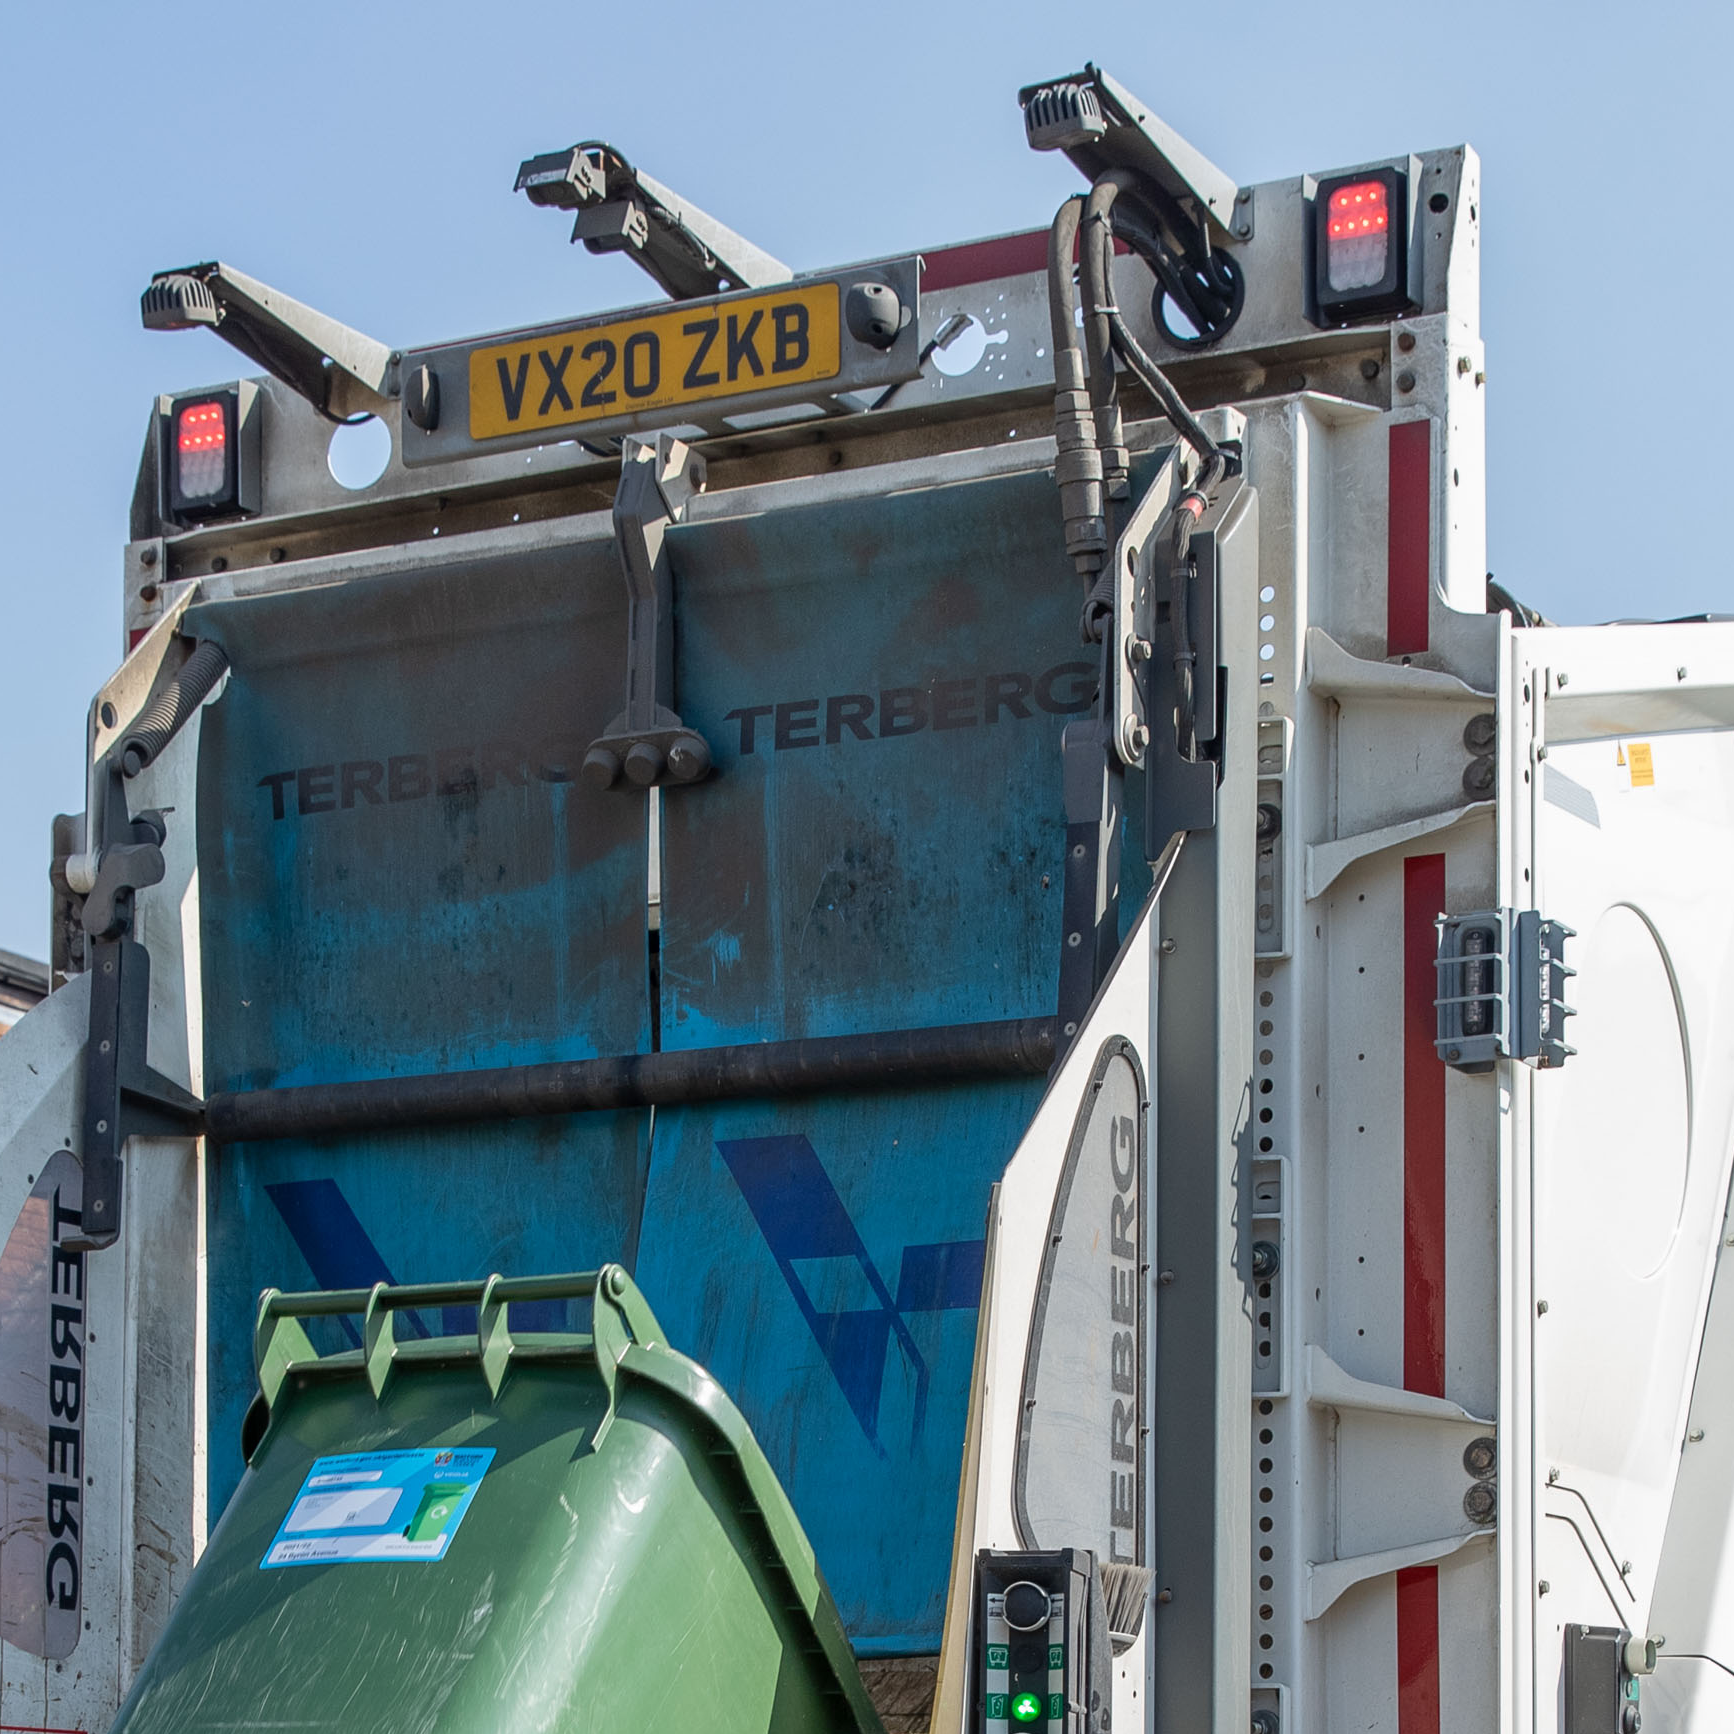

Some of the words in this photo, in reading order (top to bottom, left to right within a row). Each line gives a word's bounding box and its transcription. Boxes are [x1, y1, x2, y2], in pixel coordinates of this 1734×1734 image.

[496, 330, 661, 421] VX20
[682, 303, 810, 390] ZKB
[723, 661, 1101, 756] TERBERG
[46, 1184, 83, 1611] TERBERG
